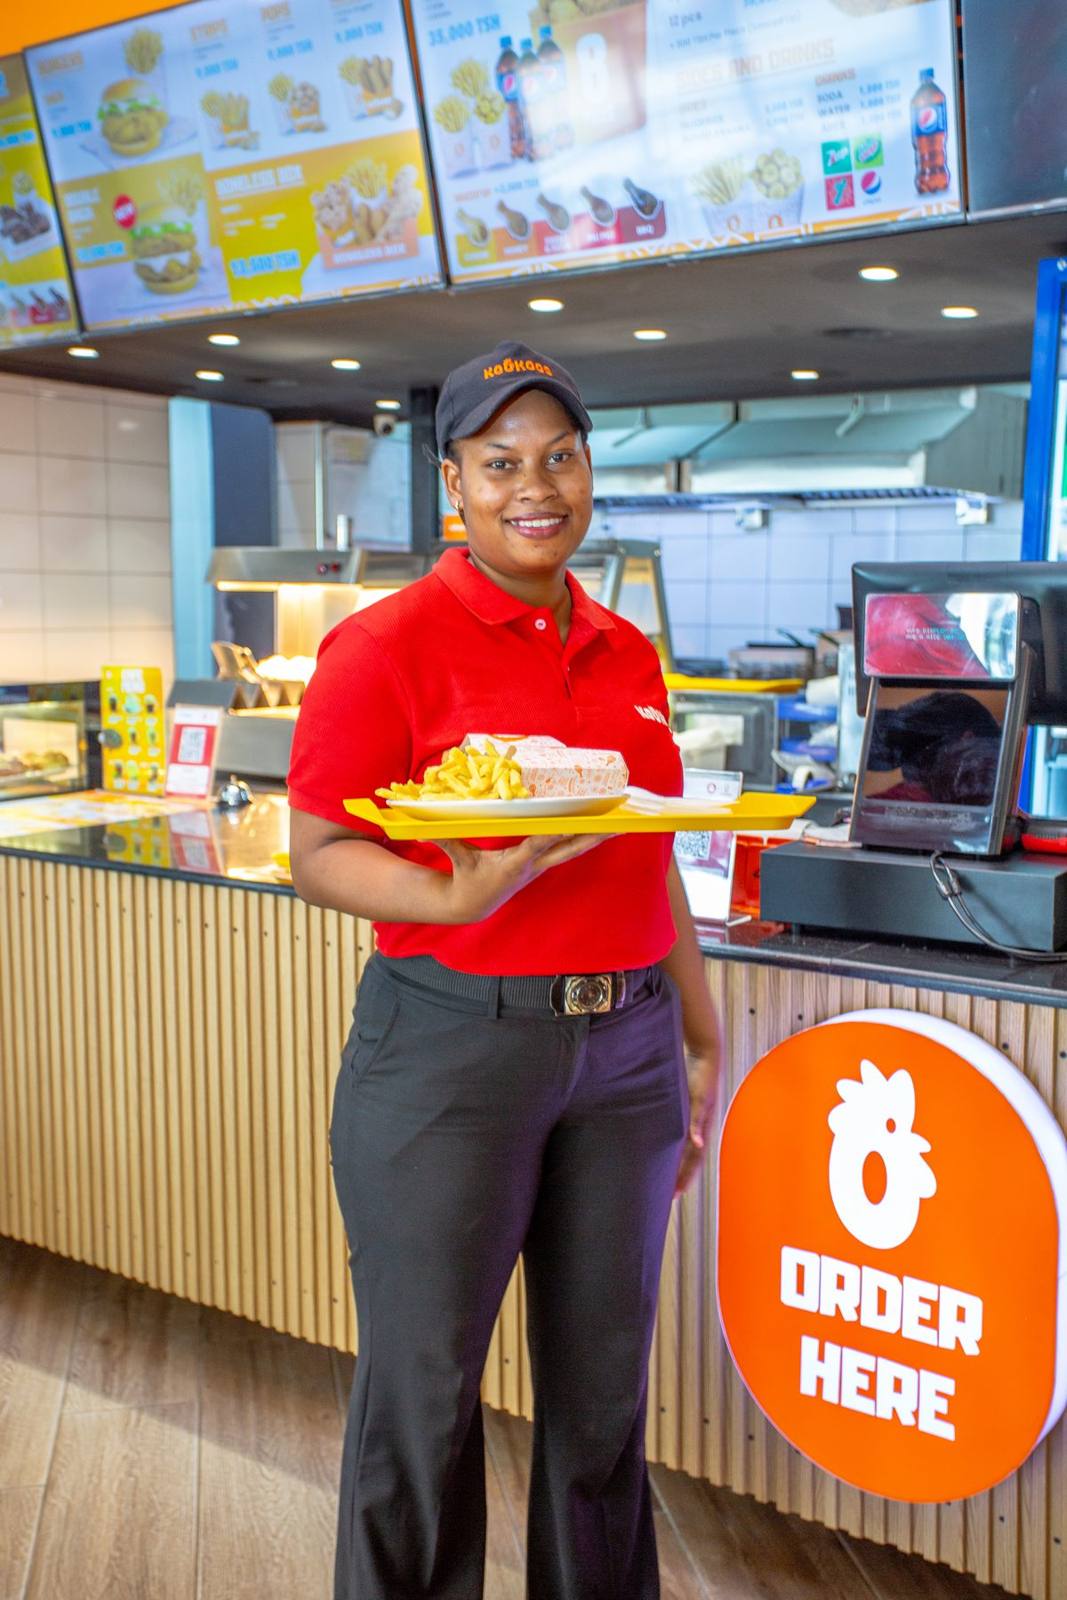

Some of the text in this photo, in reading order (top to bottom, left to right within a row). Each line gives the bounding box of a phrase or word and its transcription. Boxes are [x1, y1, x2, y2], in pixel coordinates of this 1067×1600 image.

[768, 38, 836, 71] DRINKS
[780, 1245, 983, 1356] ORDER
[800, 1334, 956, 1441] HERE
